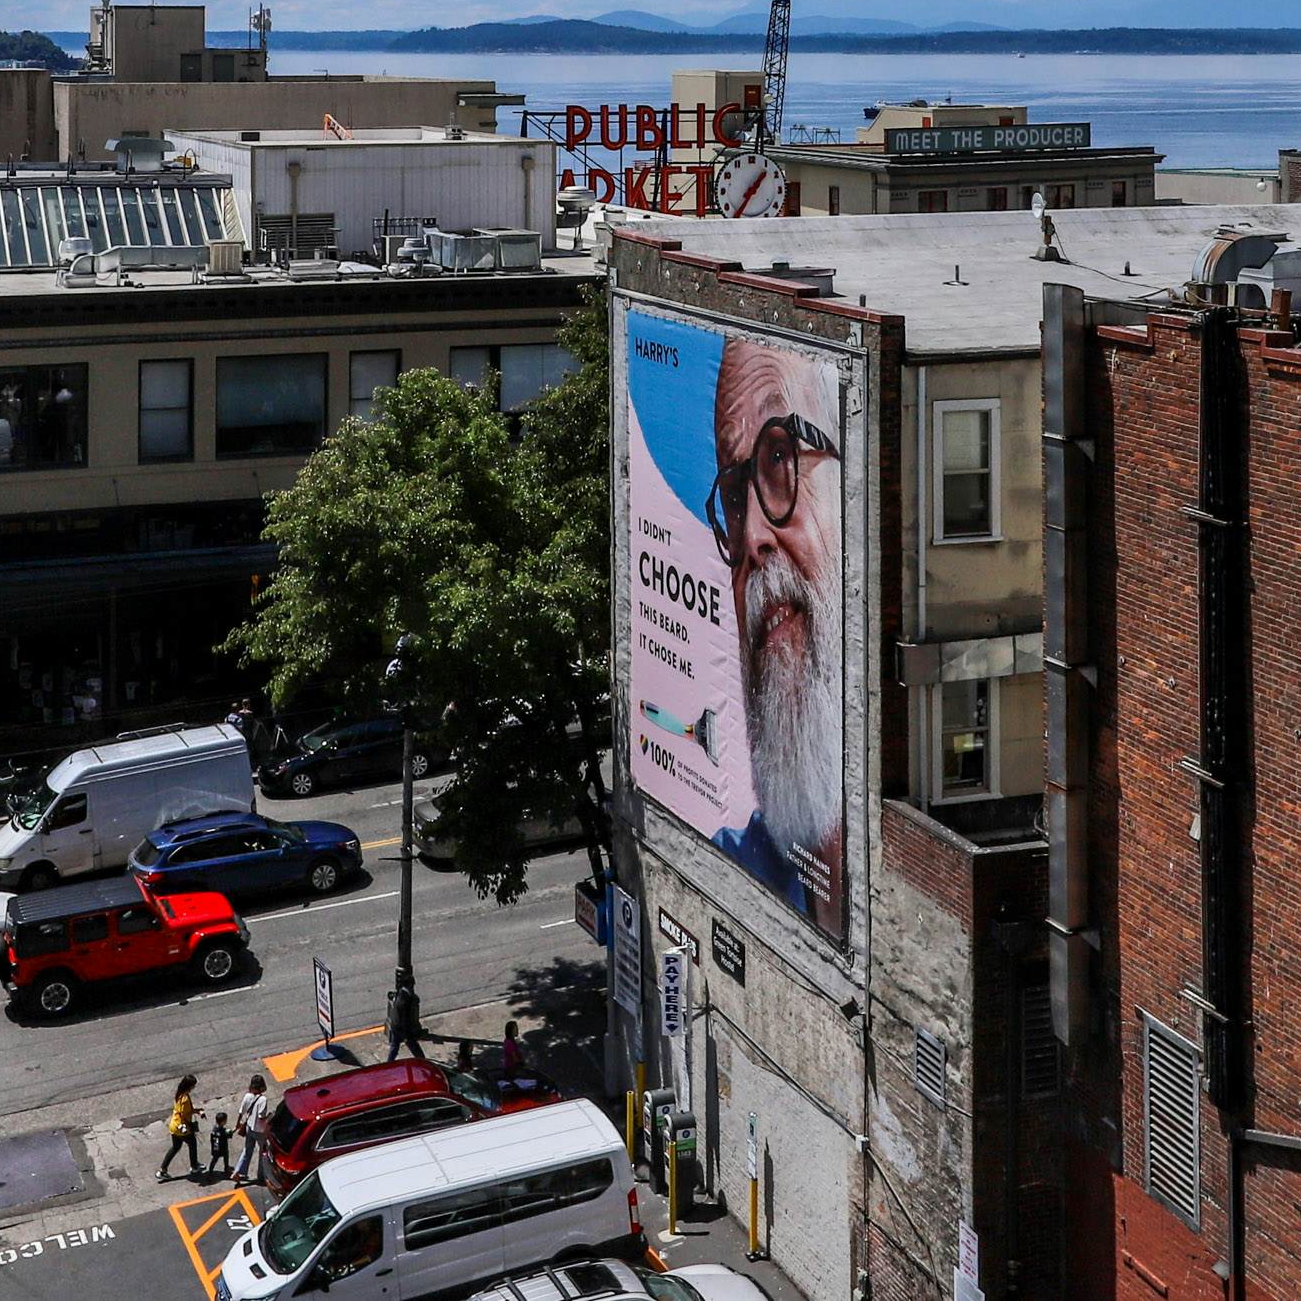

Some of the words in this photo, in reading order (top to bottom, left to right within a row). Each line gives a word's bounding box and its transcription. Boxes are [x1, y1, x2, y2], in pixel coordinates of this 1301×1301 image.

[566, 102, 742, 151] PUBLIC
[895, 131, 941, 151] MEET
[951, 129, 983, 148] THE
[994, 126, 1084, 148] PRODUCER
[559, 165, 715, 218] RKET
[635, 337, 679, 368] HARRY'S
[643, 519, 672, 547] DIDN'T
[639, 551, 720, 627] CHOOSE
[639, 601, 658, 626] THIS
[659, 612, 690, 645] BEARD.
[639, 632, 647, 649] IT
[648, 638, 678, 672] CHOSE
[679, 657, 695, 680] ME.
[651, 741, 676, 777] 100%
[660, 912, 681, 944] SMOKE
[665, 957, 679, 983] PAY
[665, 986, 679, 1022] HERE
